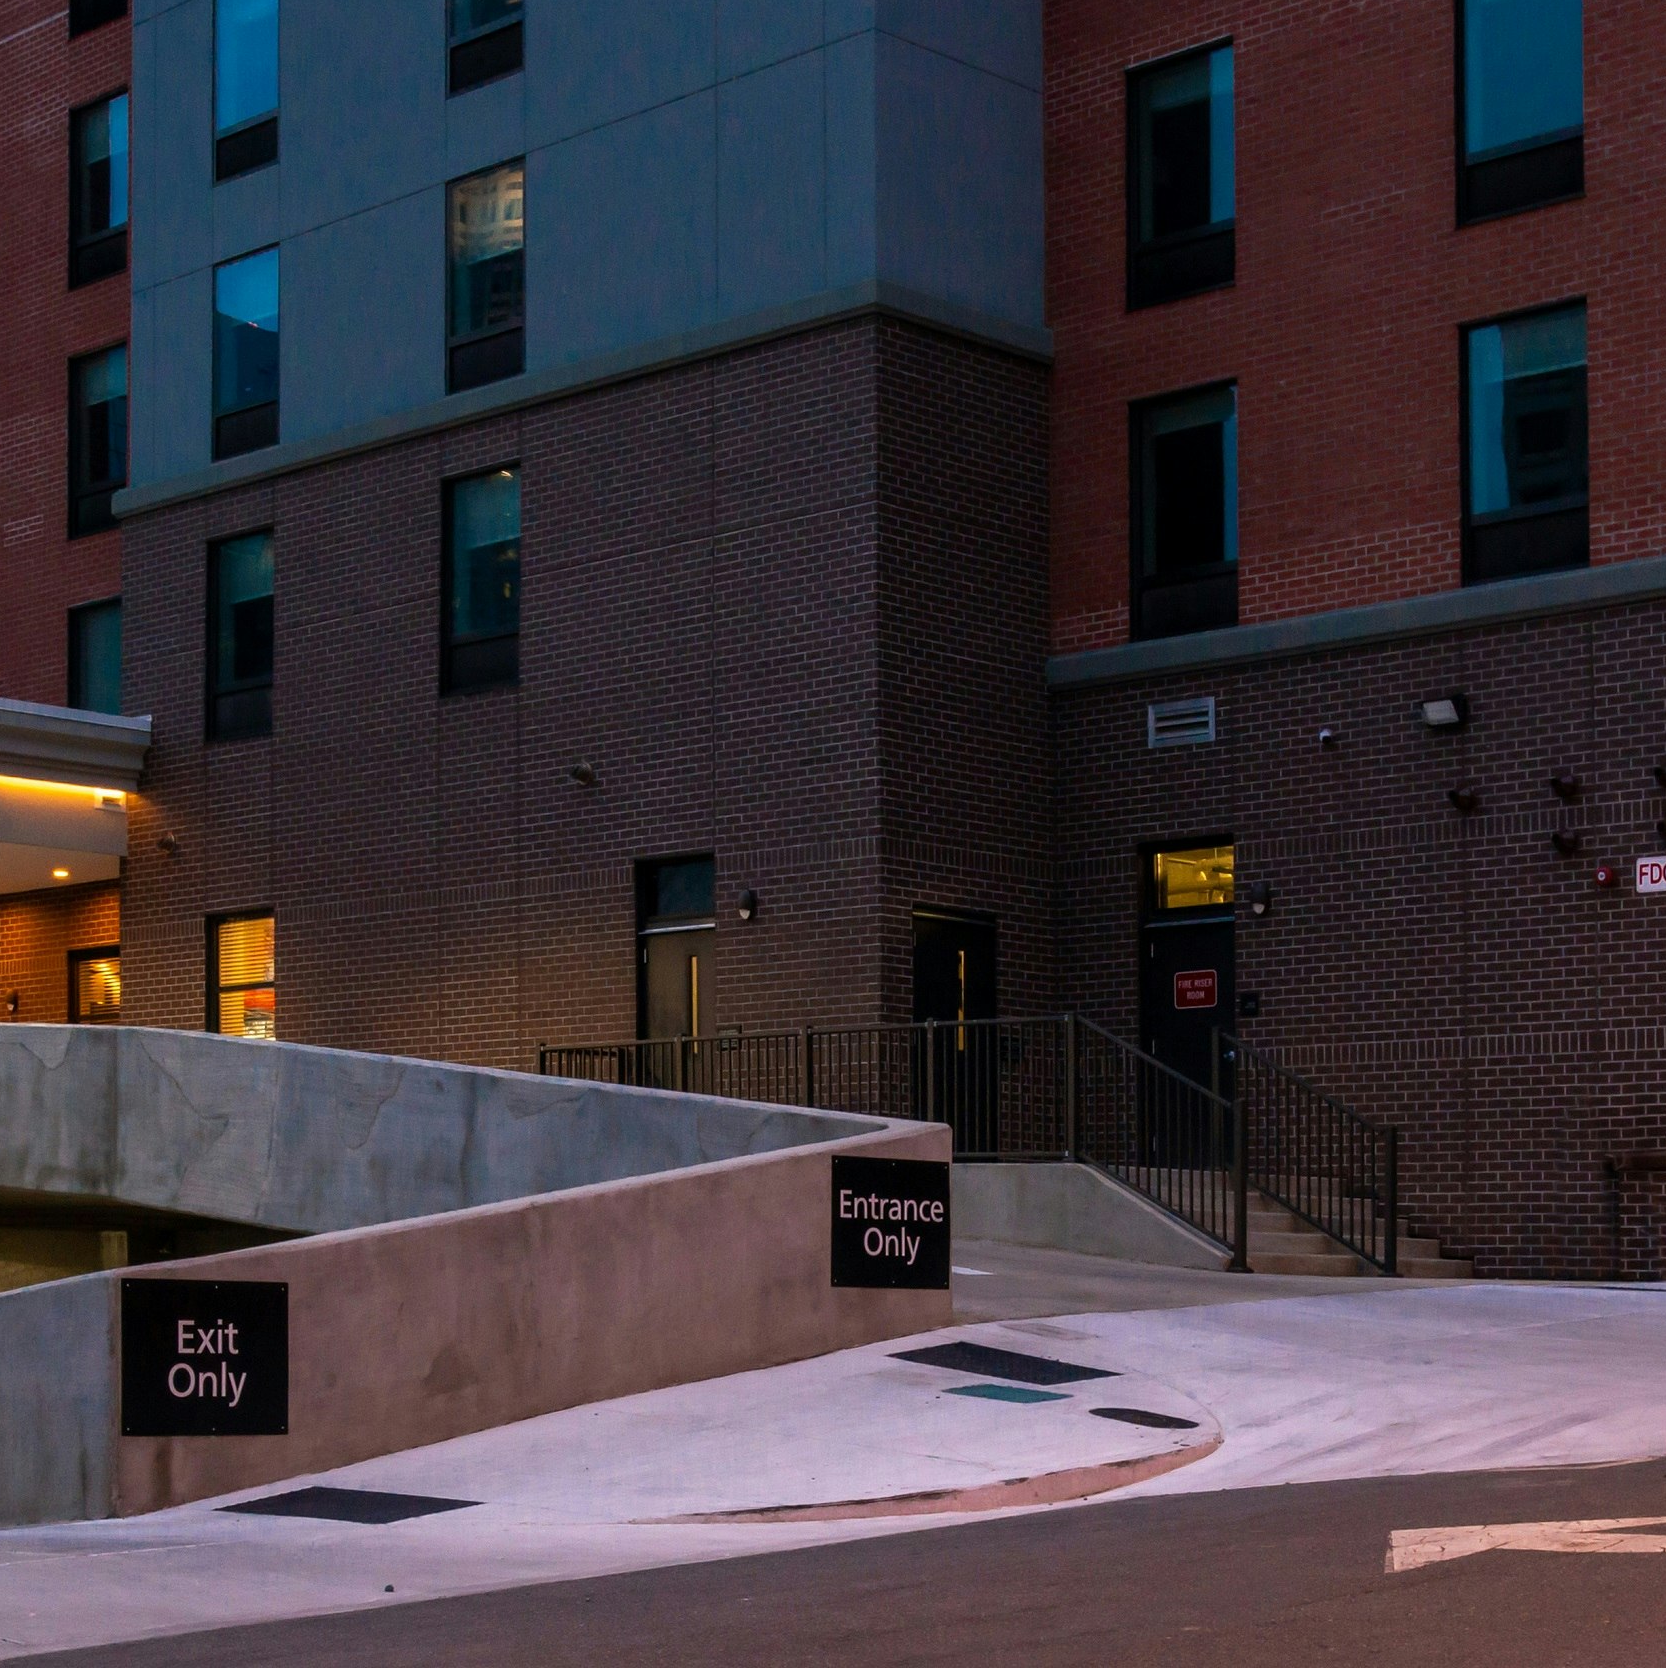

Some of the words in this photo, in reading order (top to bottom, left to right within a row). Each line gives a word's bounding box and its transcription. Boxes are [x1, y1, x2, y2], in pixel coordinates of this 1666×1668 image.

[1178, 980, 1192, 988] FIRE
[1194, 978, 1213, 987] RISER
[1186, 991, 1205, 1000] ROOM
[839, 1189, 944, 1223] Entrance
[864, 1226, 921, 1265] Only
[177, 1318, 239, 1355] Exit
[168, 1361, 247, 1407] Only
